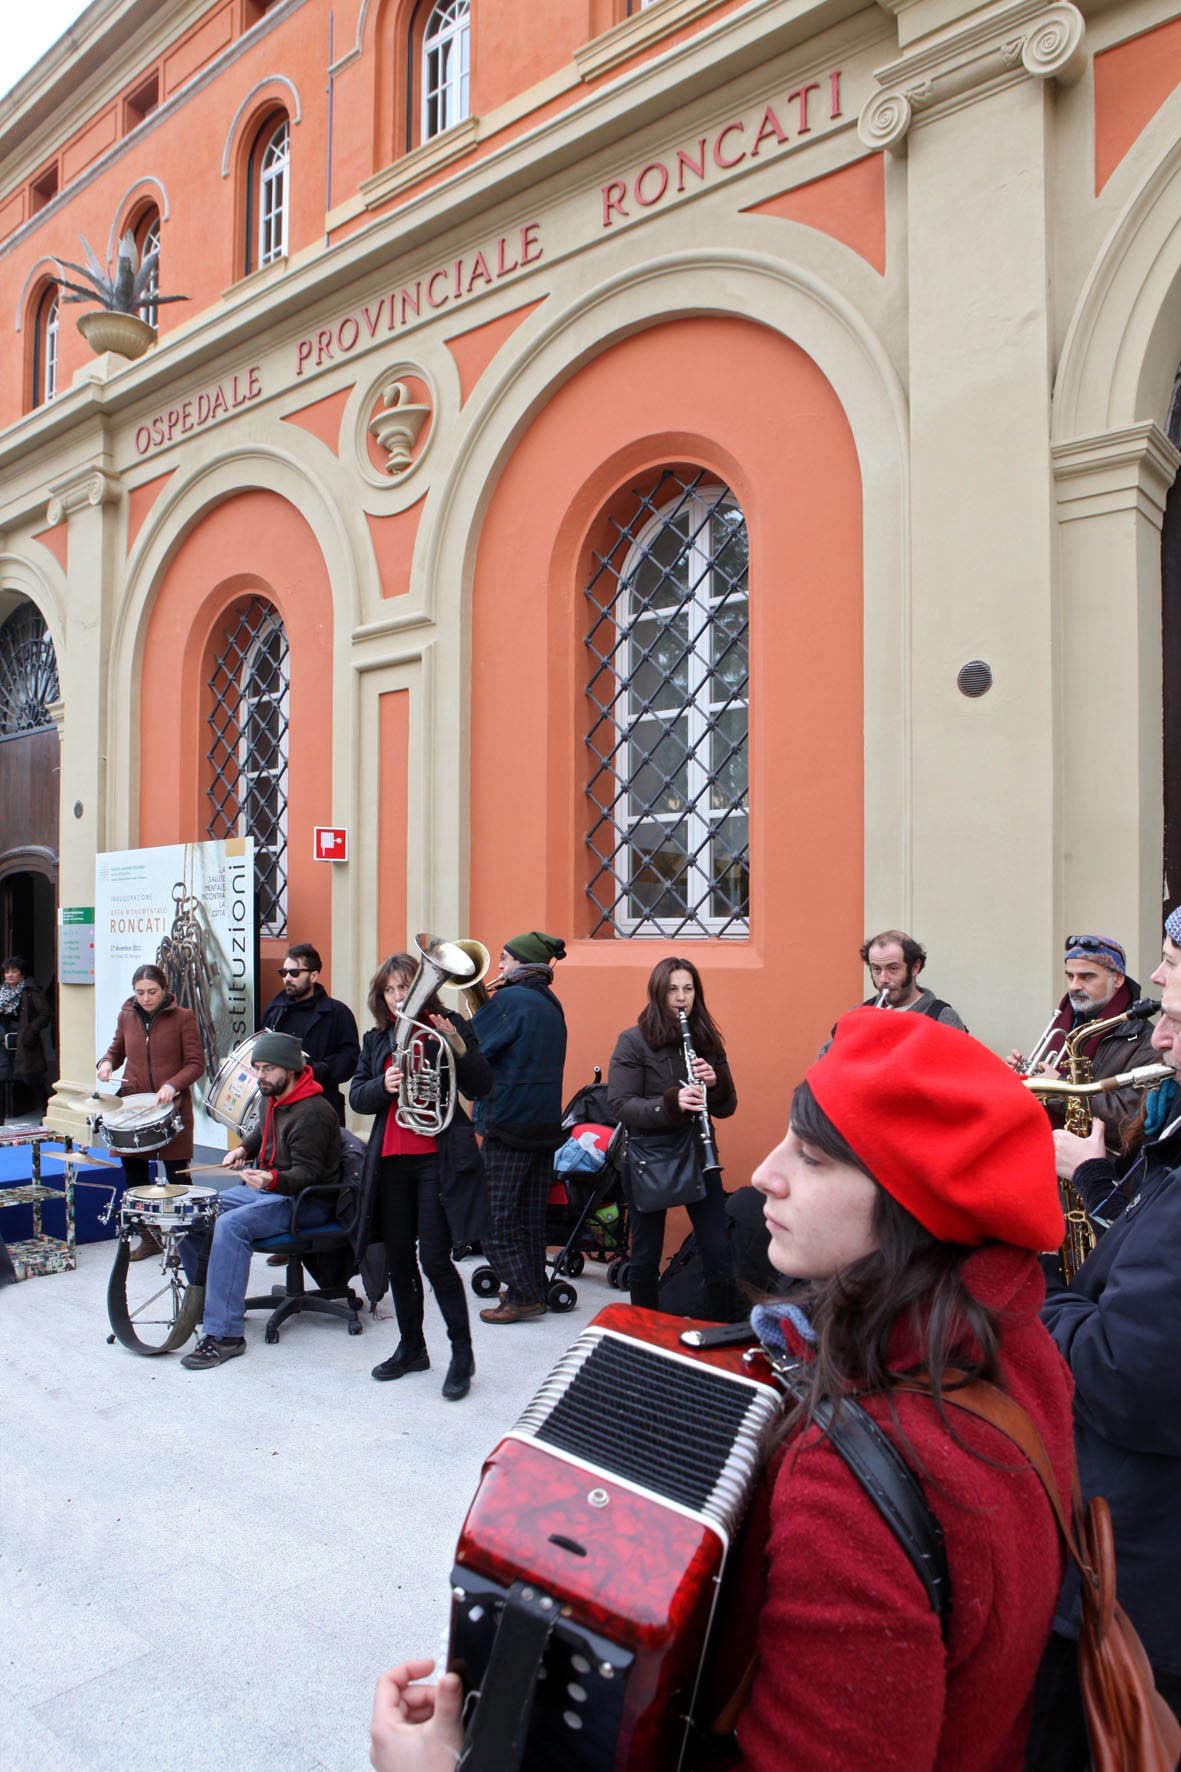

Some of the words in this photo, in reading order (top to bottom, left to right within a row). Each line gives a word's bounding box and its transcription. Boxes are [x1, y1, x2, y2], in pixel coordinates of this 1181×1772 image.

[134, 366, 262, 455] OSPEDALE
[296, 222, 543, 375] PROVINCIALE
[601, 70, 842, 227] RONCATI
[110, 917, 166, 934] RONCATI
